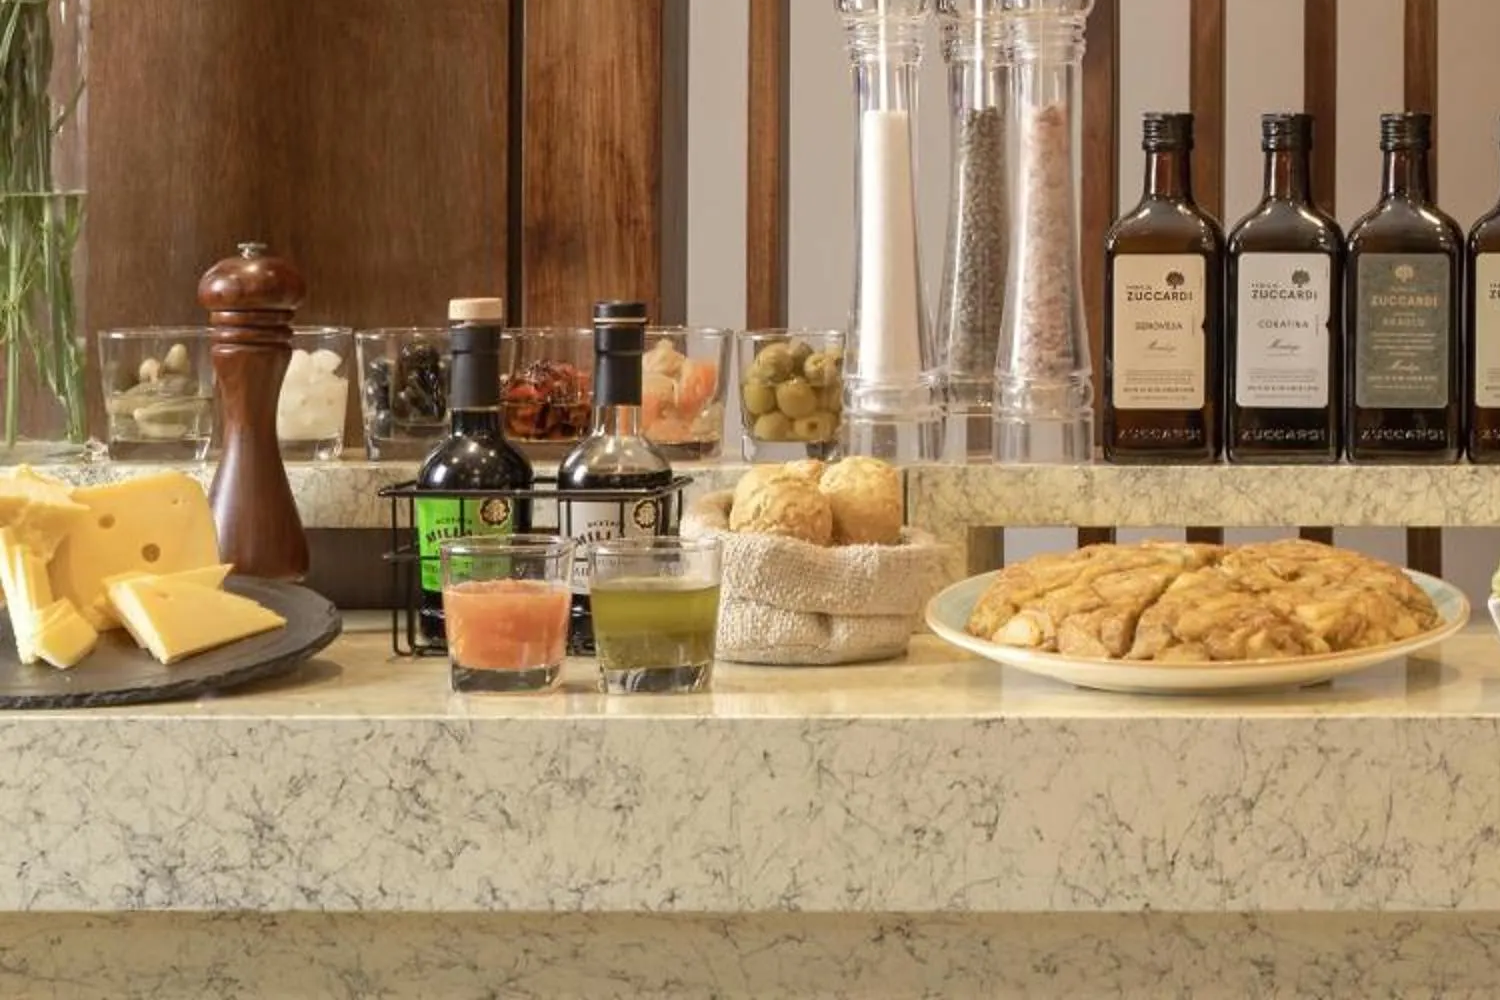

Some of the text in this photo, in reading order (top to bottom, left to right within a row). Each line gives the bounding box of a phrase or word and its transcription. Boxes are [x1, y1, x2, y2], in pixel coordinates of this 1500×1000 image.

[1126, 291, 1193, 302] ZUCCARDI
[1250, 289, 1318, 300] ZUCCARDI
[1371, 295, 1438, 308] ZUCCARDI
[1241, 428, 1325, 441] ZUCCARDI
[1361, 428, 1445, 441] ZUCCARDI
